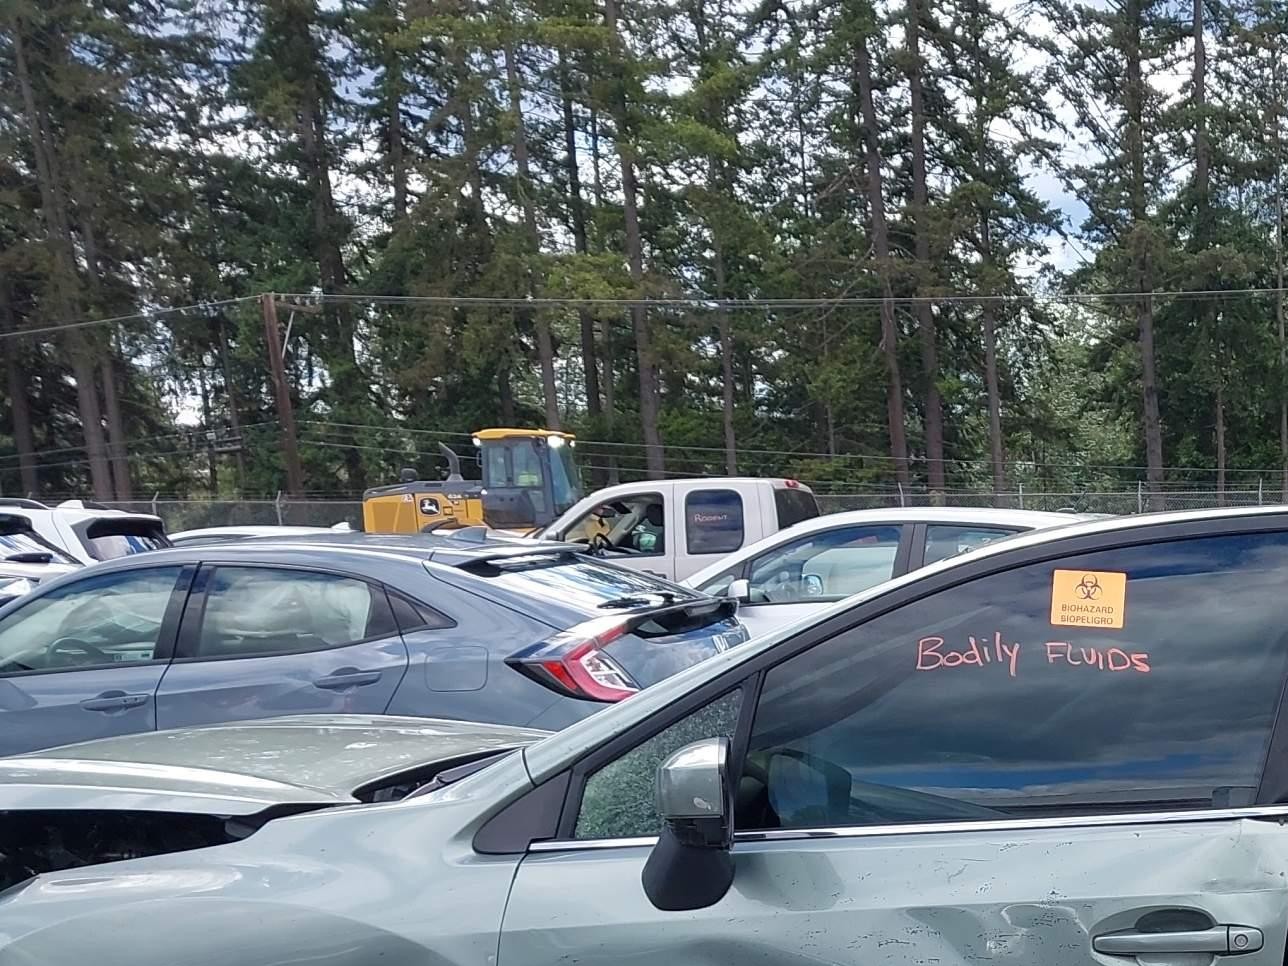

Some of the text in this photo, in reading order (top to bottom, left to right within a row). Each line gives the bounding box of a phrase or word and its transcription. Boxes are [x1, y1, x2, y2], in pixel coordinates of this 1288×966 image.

[1061, 604, 1114, 614] BIOHAZARD
[1060, 615, 1113, 625] BIOPELIGRO
[916, 631, 1151, 677] Bodily FLUIDS
